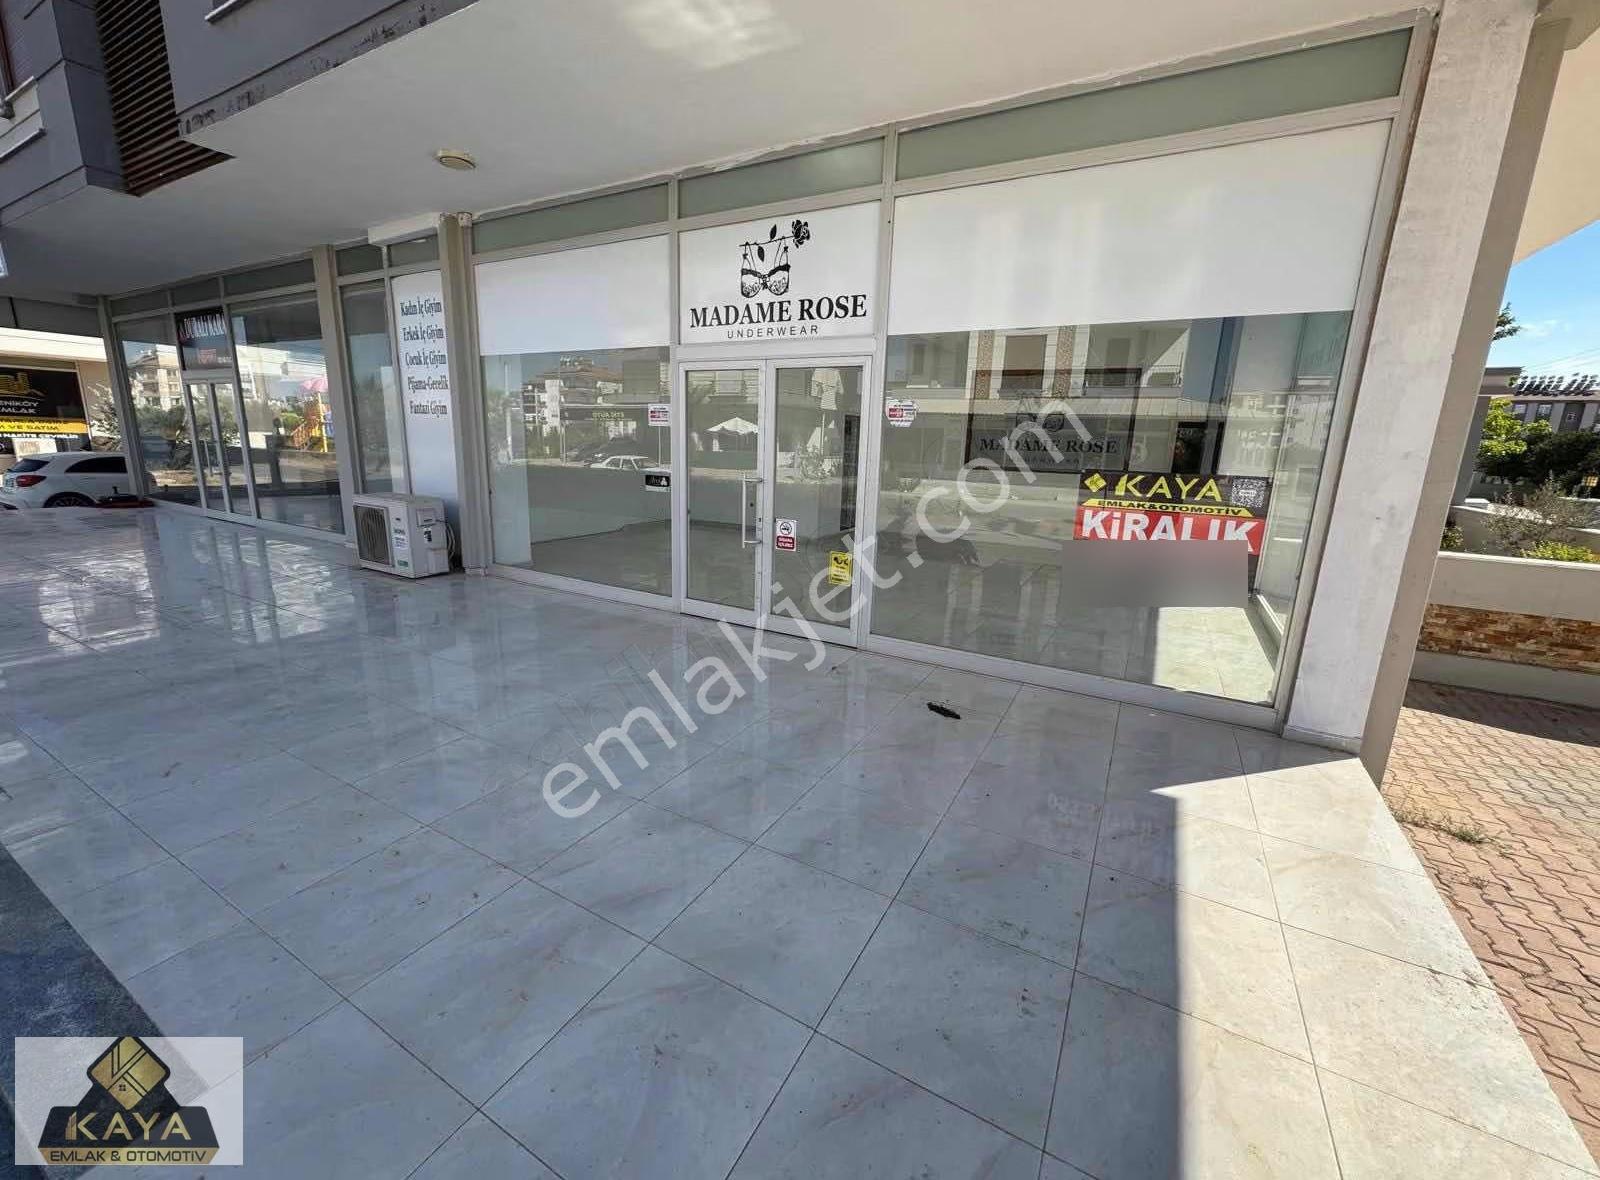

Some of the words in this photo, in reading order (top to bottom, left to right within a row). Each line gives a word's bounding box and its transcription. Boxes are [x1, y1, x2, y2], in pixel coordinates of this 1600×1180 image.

[424, 298, 442, 316] Giyim
[690, 301, 792, 328] MADAME
[798, 294, 867, 321] ROSE
[403, 326, 419, 341] Erkek
[426, 324, 444, 342] Giyim
[727, 325, 818, 339] UNDERWEAR
[429, 350, 446, 368] Giyim
[430, 400, 447, 418] Giyim
[1115, 474, 1222, 502] KAYA
